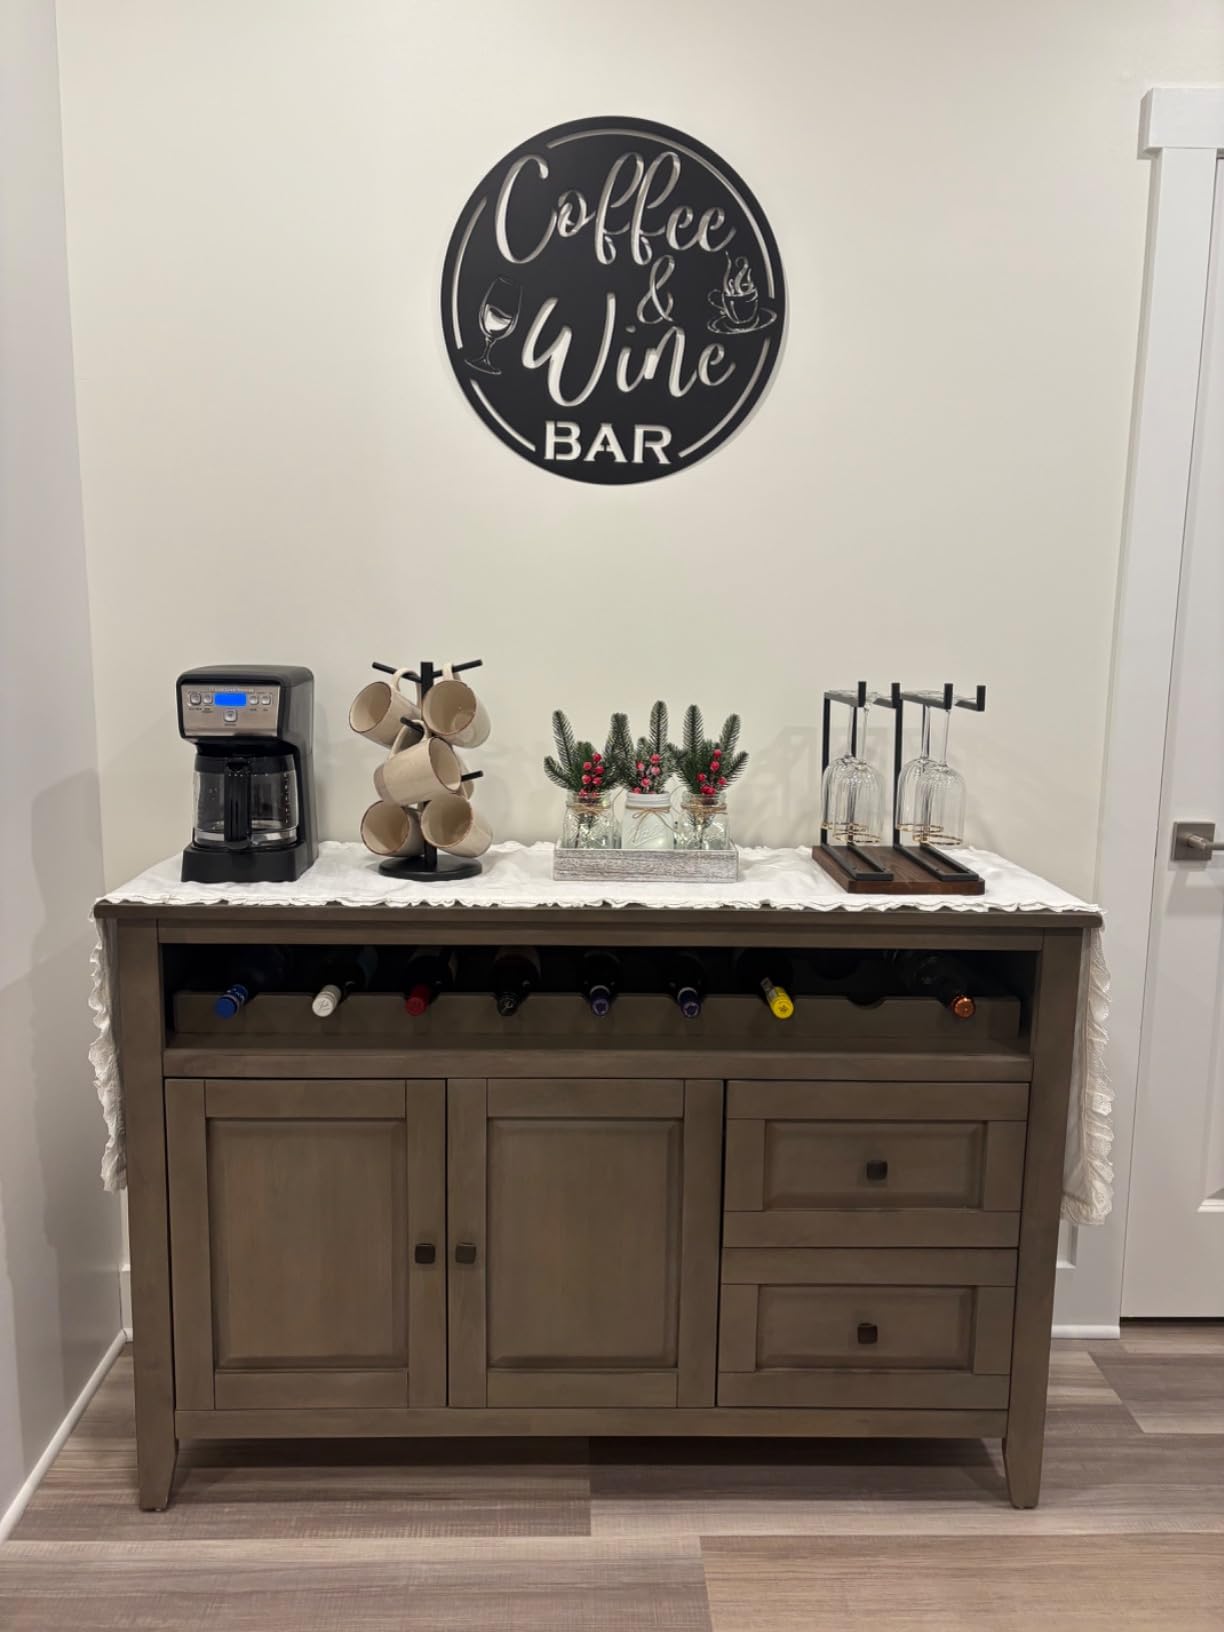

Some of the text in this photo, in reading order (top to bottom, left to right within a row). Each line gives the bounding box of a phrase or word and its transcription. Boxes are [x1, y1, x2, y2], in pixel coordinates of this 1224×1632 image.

[496, 151, 736, 265] Coffee
[637, 255, 676, 325] &
[521, 293, 736, 407] Wine
[543, 420, 673, 465] BAR
